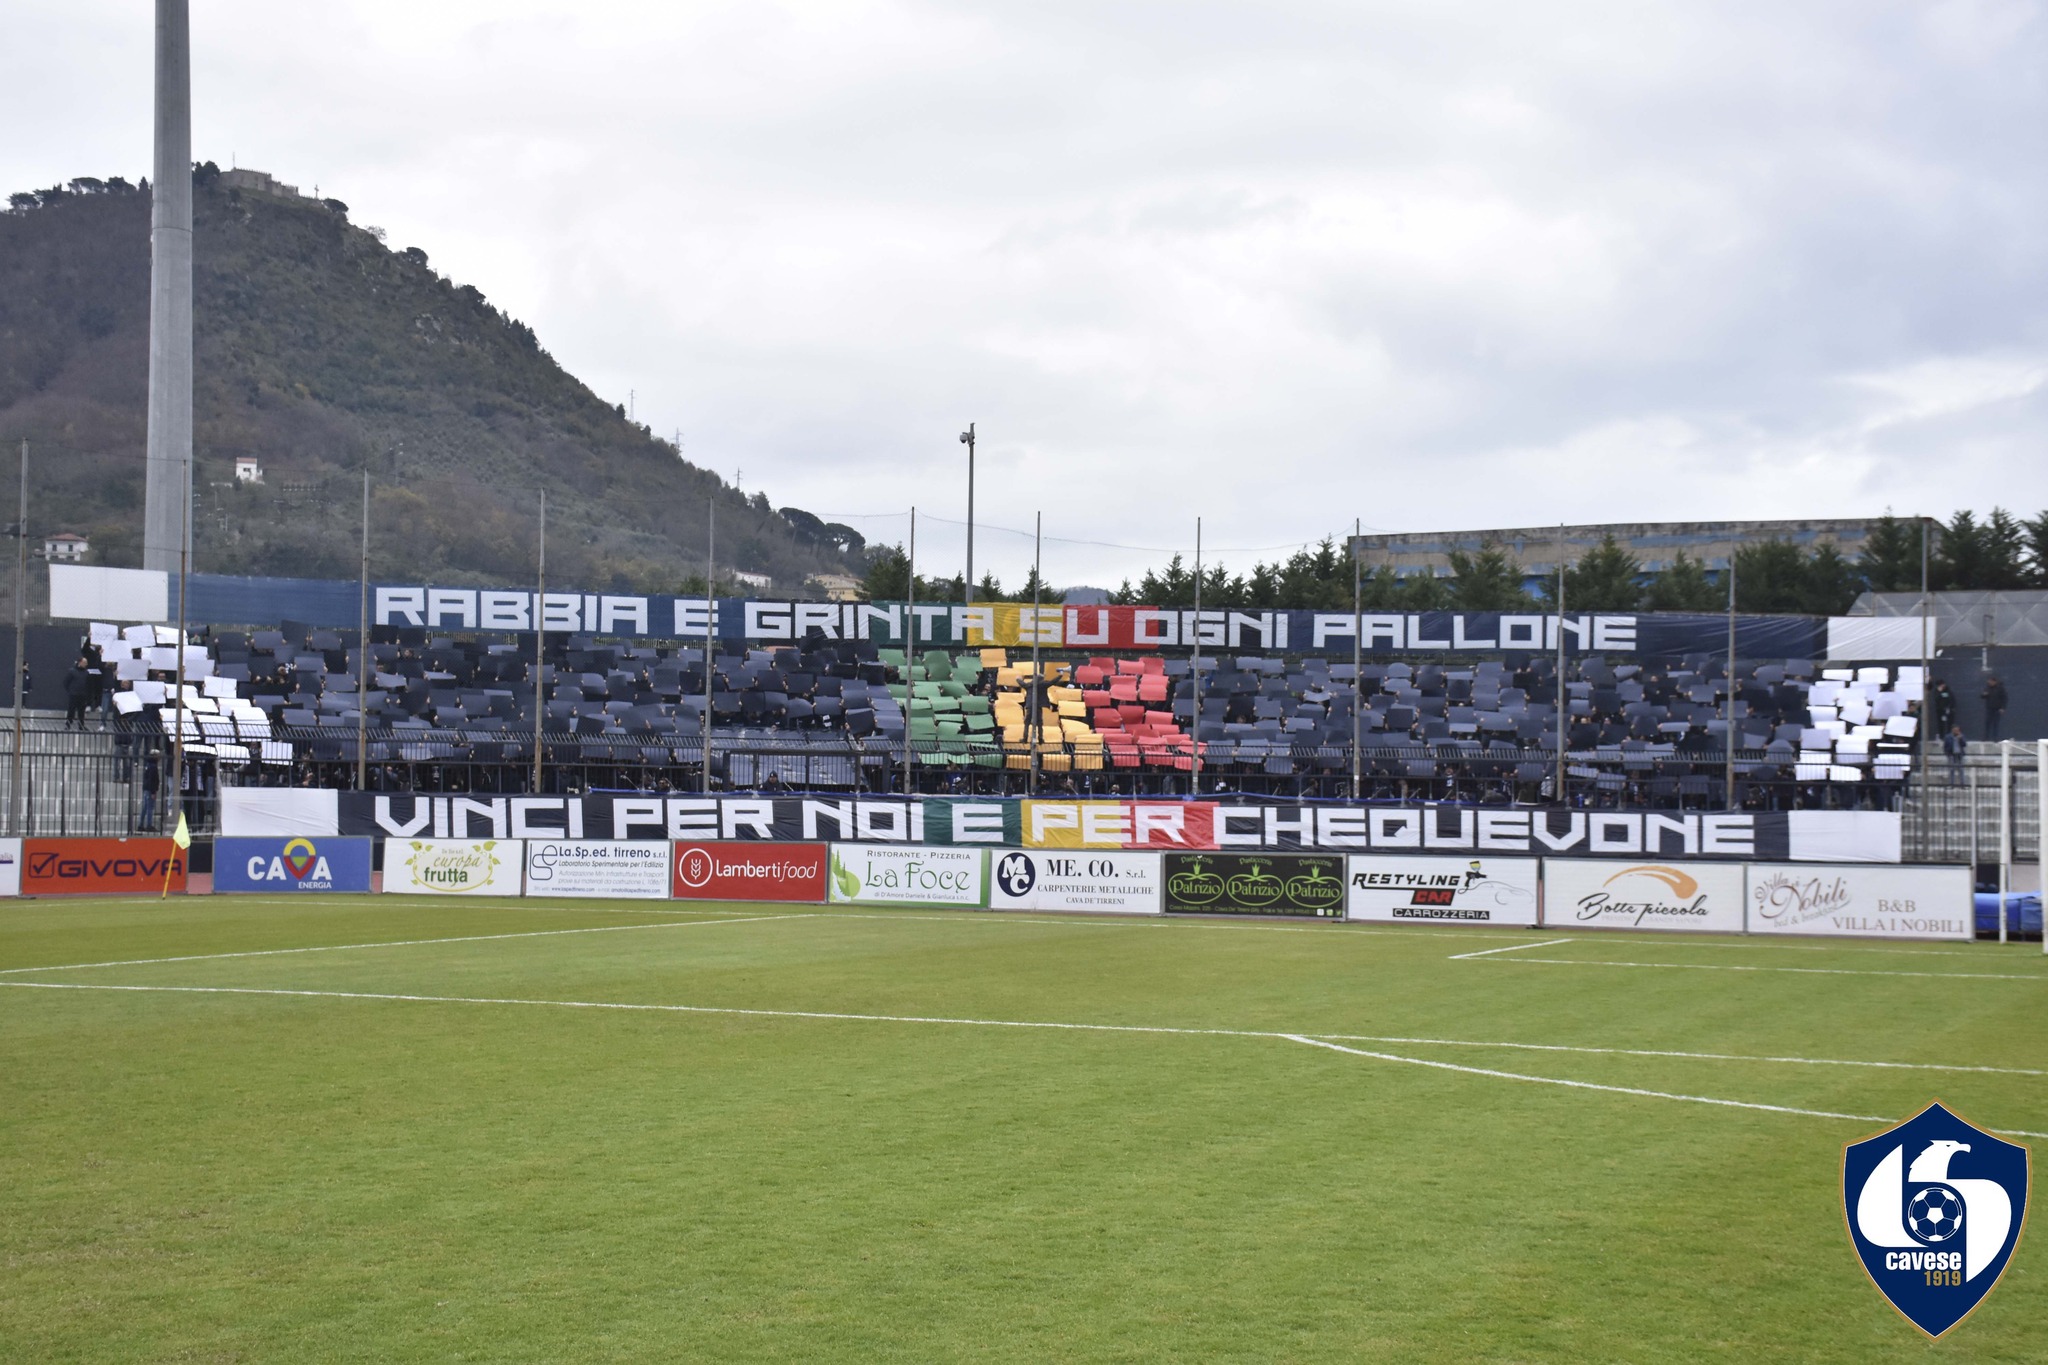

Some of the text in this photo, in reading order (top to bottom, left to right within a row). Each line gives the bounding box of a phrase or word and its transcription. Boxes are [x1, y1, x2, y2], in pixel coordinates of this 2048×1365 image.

[375, 587, 1637, 650] RABBIA E GRINTA SU OGNI PALLONE
[375, 796, 1755, 854] VINCI PER NOI E PER CHEQUEVONE
[559, 846, 610, 859] La.Sp.ed.
[614, 847, 651, 858] tirreno
[867, 850, 920, 858] RISTORANTE
[930, 851, 971, 860] PIZZERIA
[58, 859, 182, 878] GIVOVA
[247, 846, 333, 880] CAVA
[433, 854, 482, 869] europa
[559, 860, 590, 868] Laboratorio
[592, 860, 628, 868] Sperimentale
[1046, 859, 1082, 877] ME.
[1088, 859, 1119, 878] CO.
[424, 867, 468, 884] frutta
[716, 859, 818, 882] Lambertifood
[865, 861, 971, 893] La Foce
[298, 881, 332, 889] ENERGIA
[1173, 880, 1221, 894] Patrizio
[1352, 873, 1460, 887] RESTYLING
[1037, 884, 1154, 895] CARPENTERIE METALLICHE
[1231, 881, 1280, 896] Patrizio
[1290, 882, 1340, 898] Patrizio
[1066, 896, 1083, 904] CAVA
[1096, 897, 1125, 905] TIRRENI
[1414, 891, 1452, 903] CAR
[1759, 876, 1847, 919] Nobili
[1576, 892, 1709, 926] Botte piccola
[1878, 899, 1916, 912] B&B
[1393, 909, 1489, 919] CARROZZERIA
[1832, 917, 1964, 933] VILLA I NOBILI
